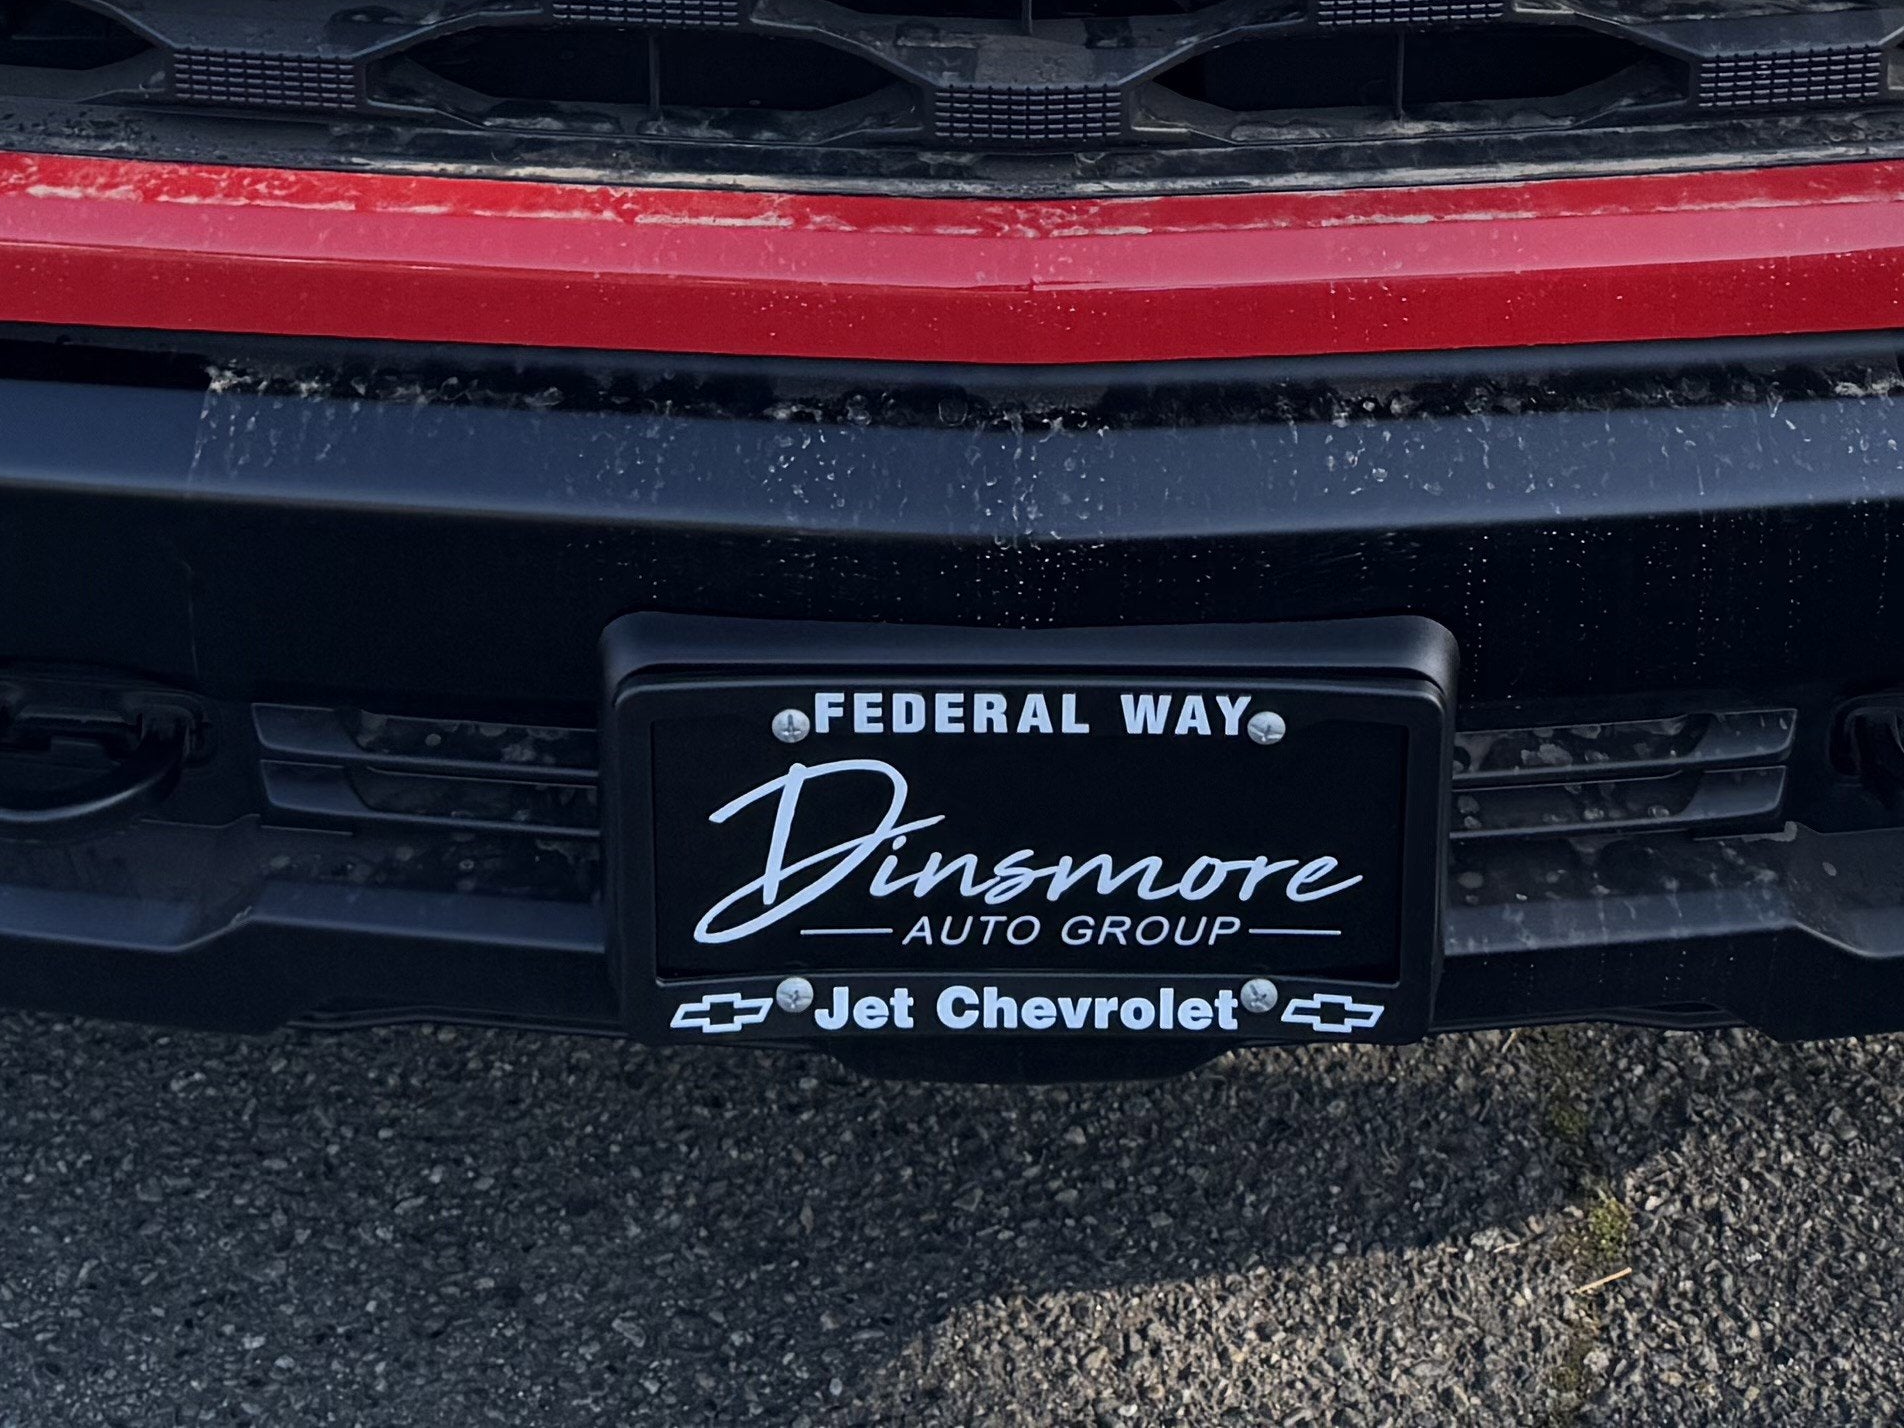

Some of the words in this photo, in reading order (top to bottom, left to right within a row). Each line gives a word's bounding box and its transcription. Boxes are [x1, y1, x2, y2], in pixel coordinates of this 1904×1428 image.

[814, 692, 1090, 734] FEDERAL
[1120, 693, 1252, 736] WAY
[693, 758, 1364, 944] Dinsmore
[901, 915, 1041, 945] AUTO
[1060, 915, 1242, 946] GROUP
[813, 985, 915, 1031] Jet
[935, 984, 1239, 1031] Chevrolet
